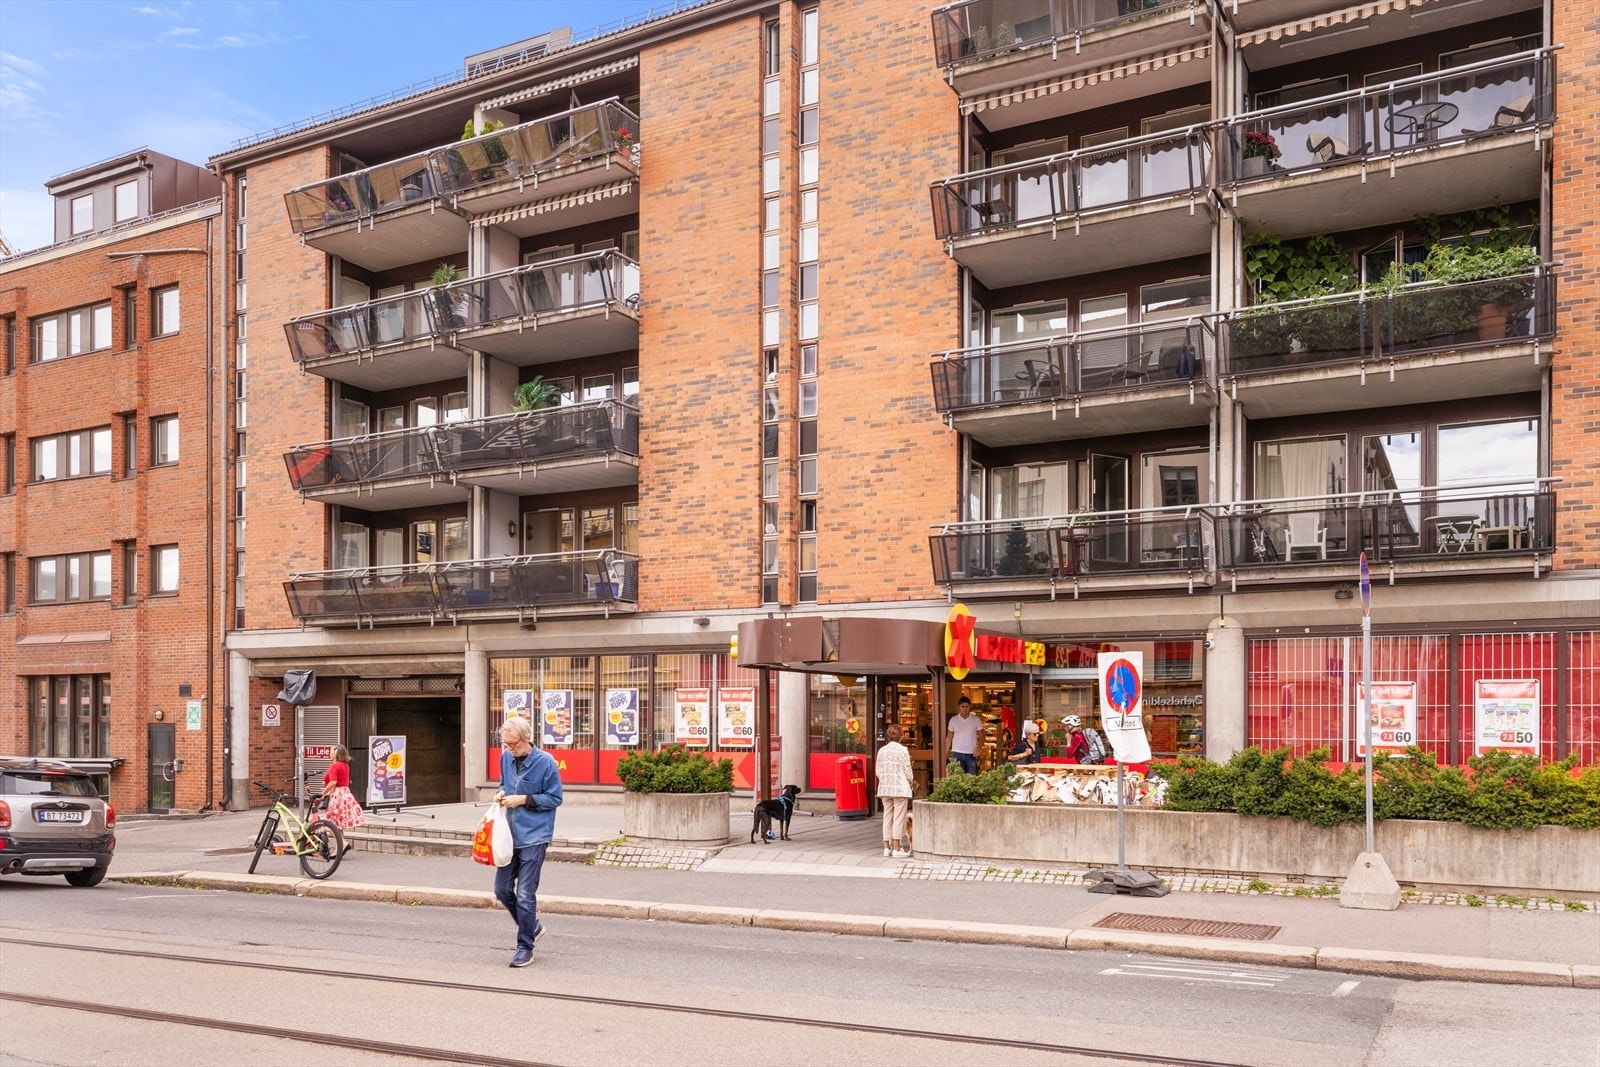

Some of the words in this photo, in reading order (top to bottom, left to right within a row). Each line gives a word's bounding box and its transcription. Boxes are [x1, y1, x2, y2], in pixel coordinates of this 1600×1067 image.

[978, 635, 1026, 664] EXTRA
[698, 727, 708, 735] 60
[743, 727, 753, 735] 60
[1395, 732, 1411, 742] 60
[1516, 732, 1533, 743] 50
[47, 812, 55, 820] BT
[59, 812, 80, 820] 73472
